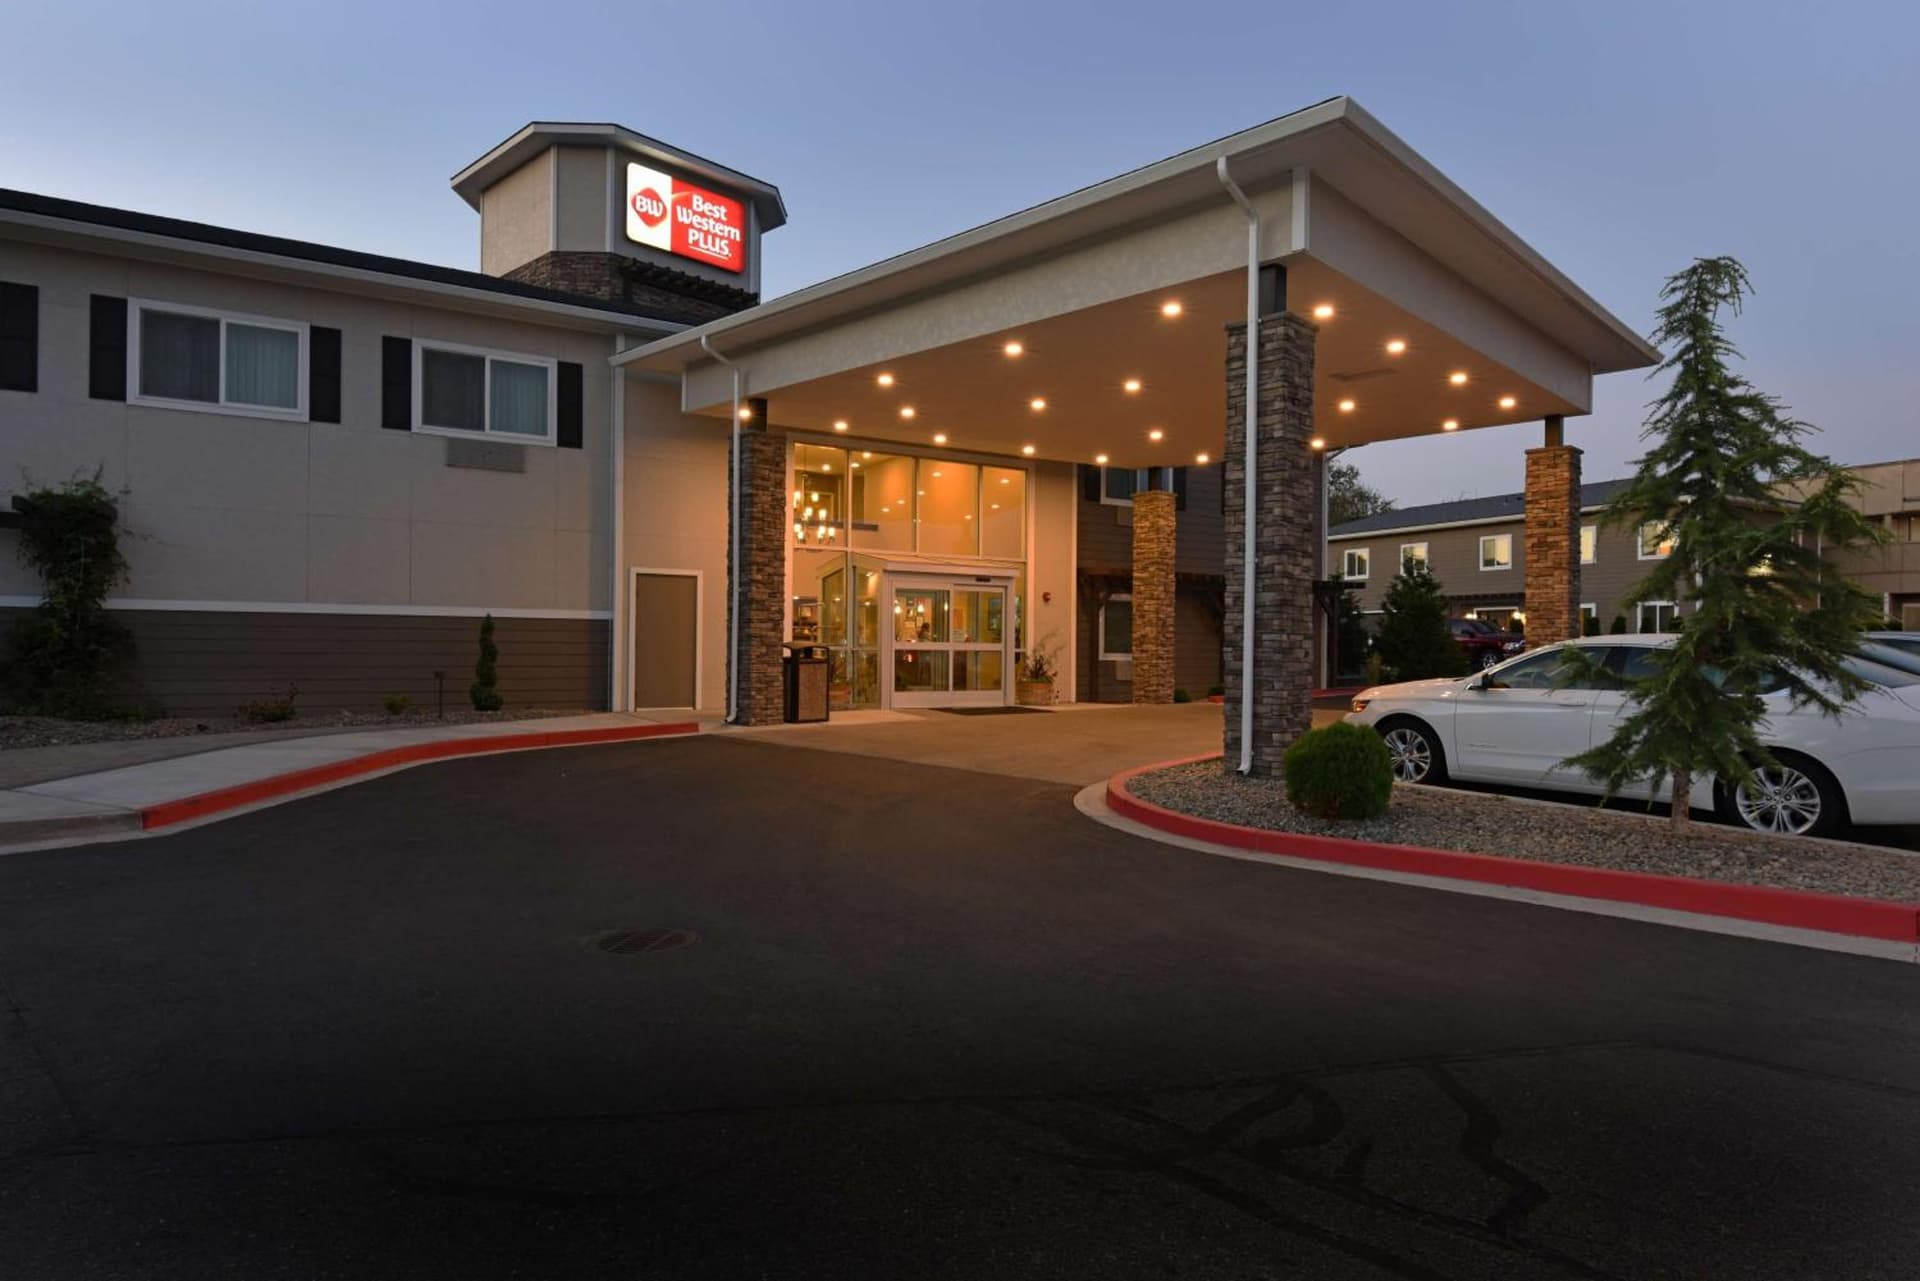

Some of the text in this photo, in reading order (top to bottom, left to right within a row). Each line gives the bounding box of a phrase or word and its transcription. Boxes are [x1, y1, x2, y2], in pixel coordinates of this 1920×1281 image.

[635, 195, 663, 217] BW
[692, 194, 727, 221] Best
[676, 205, 741, 243] Western
[687, 228, 729, 256] PLUS
